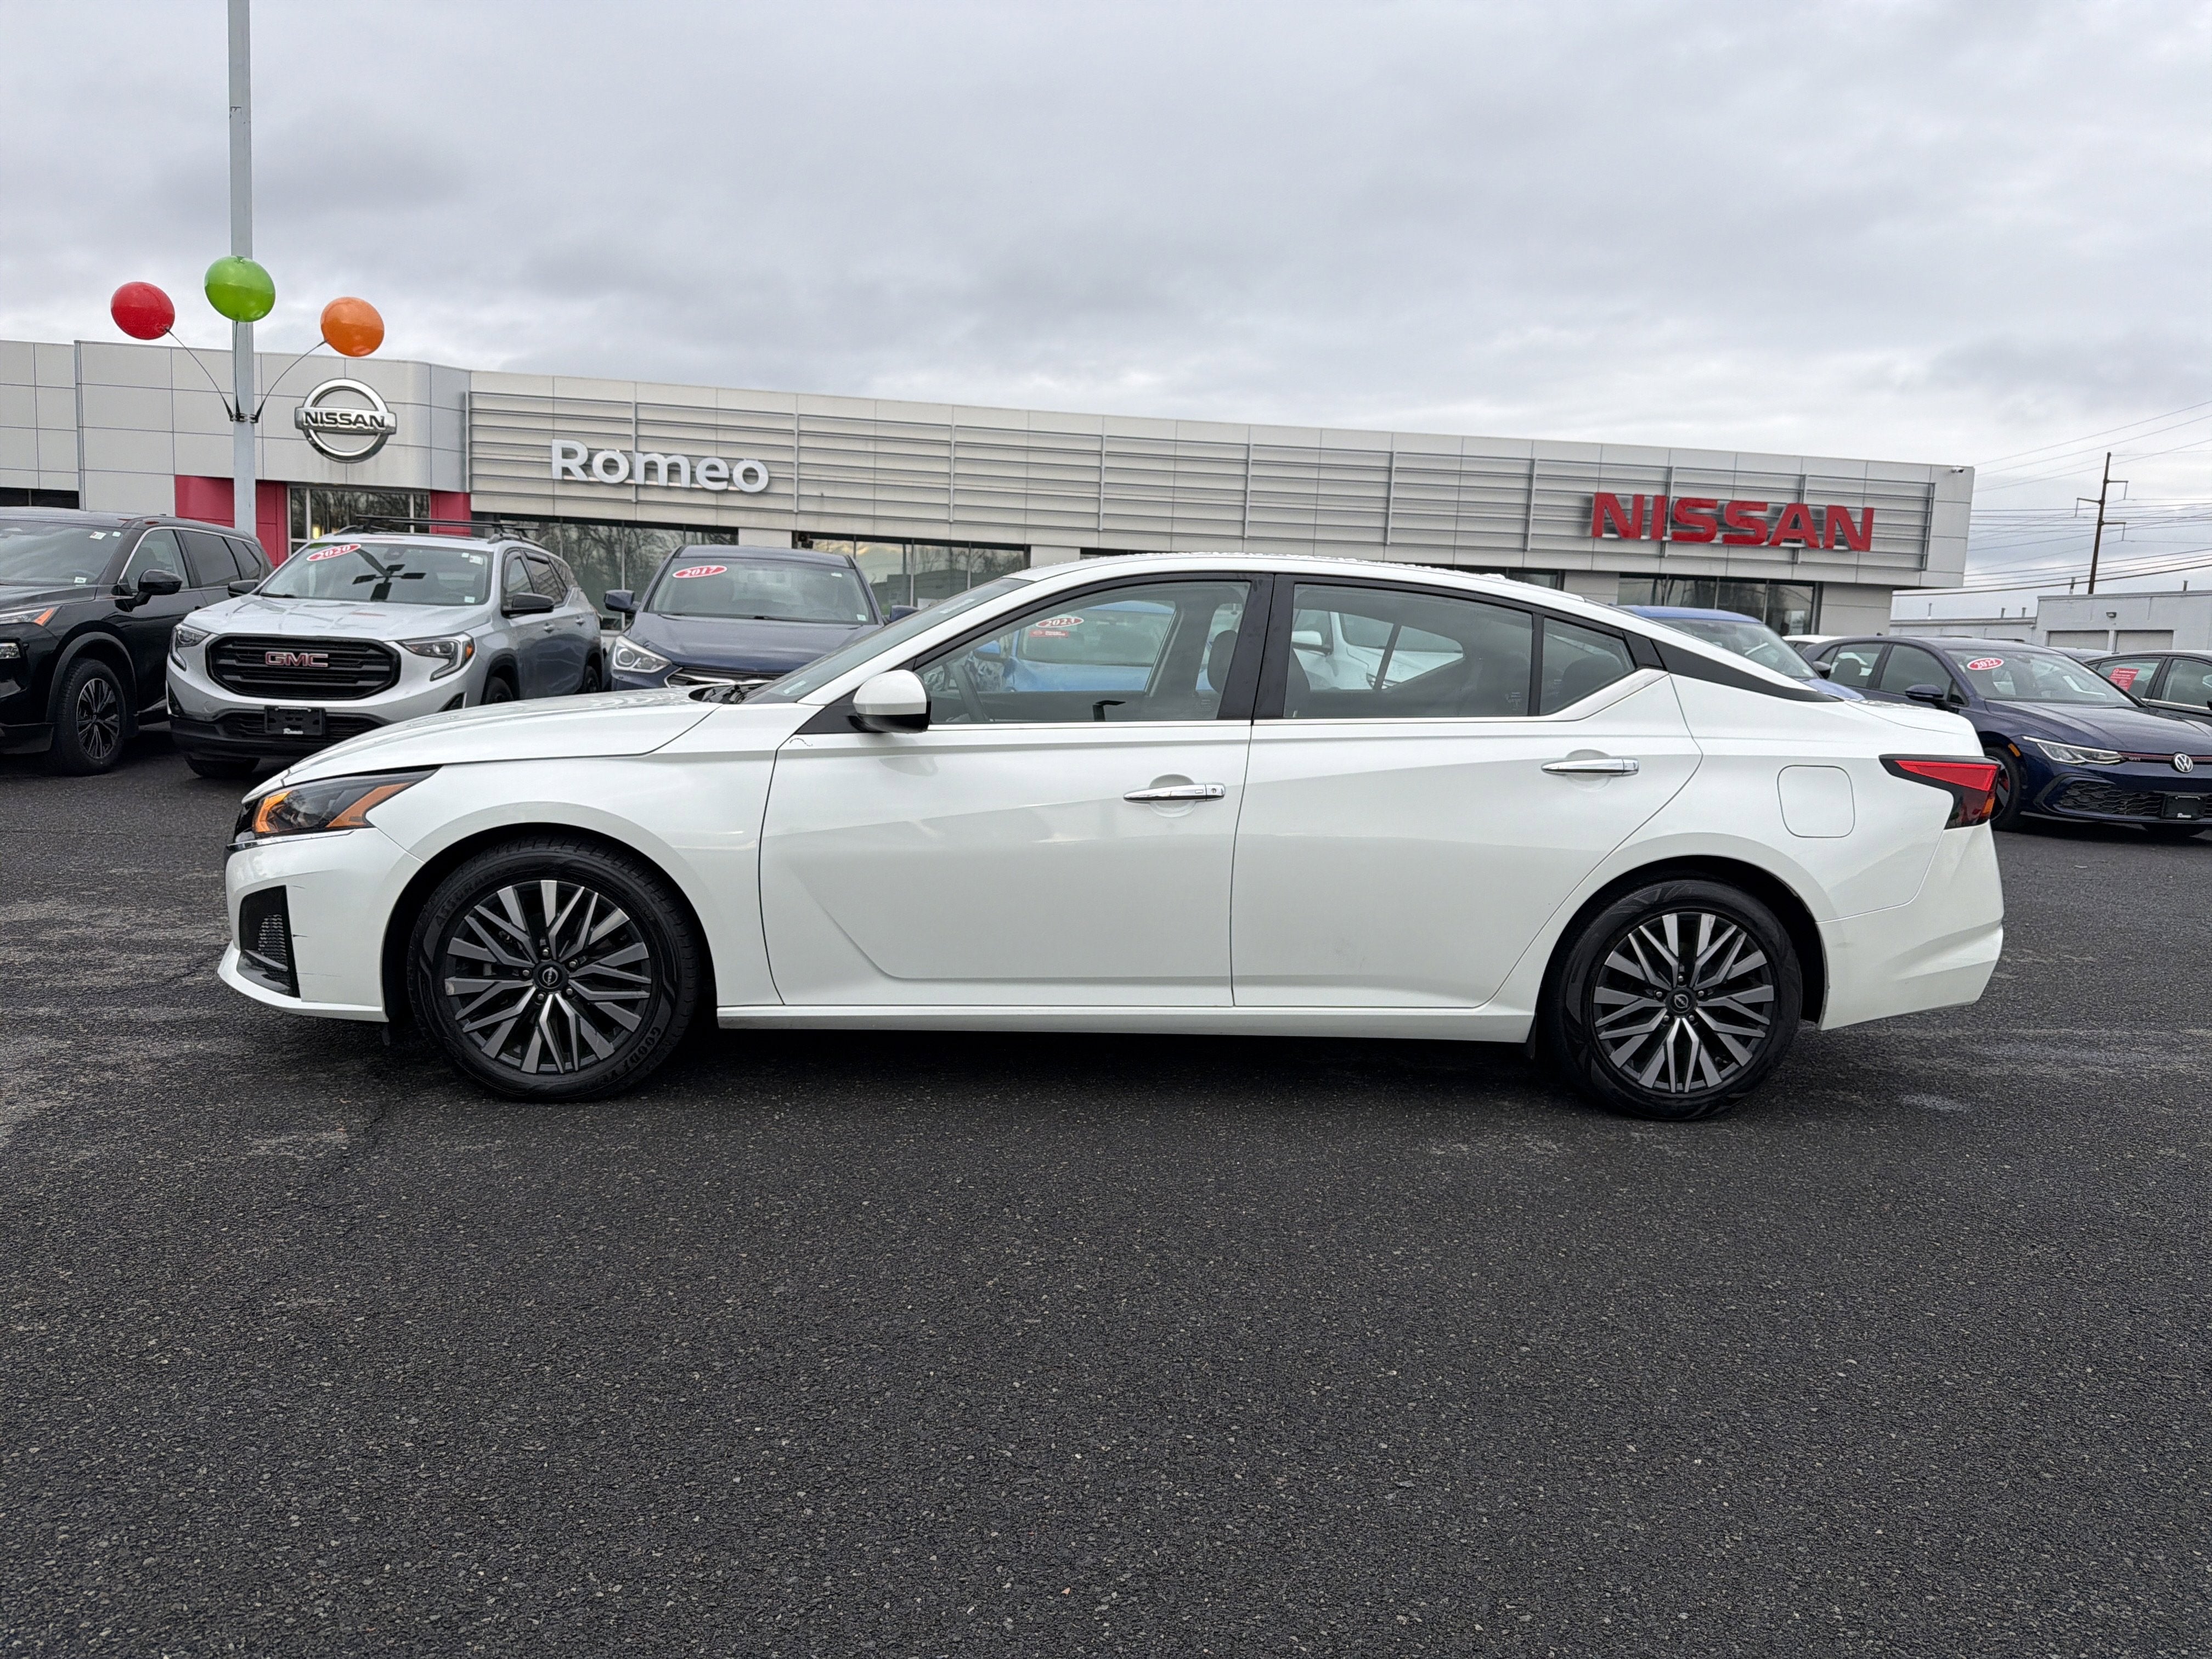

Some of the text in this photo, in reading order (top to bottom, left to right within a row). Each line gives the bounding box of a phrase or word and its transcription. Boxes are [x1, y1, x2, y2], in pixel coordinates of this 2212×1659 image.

[303, 411, 386, 429] NISSAN
[552, 438, 769, 493] Romeo
[1592, 492, 1875, 552] NISSAN
[318, 545, 350, 558] 2020
[683, 566, 717, 577] 2017
[266, 652, 329, 668] GMC
